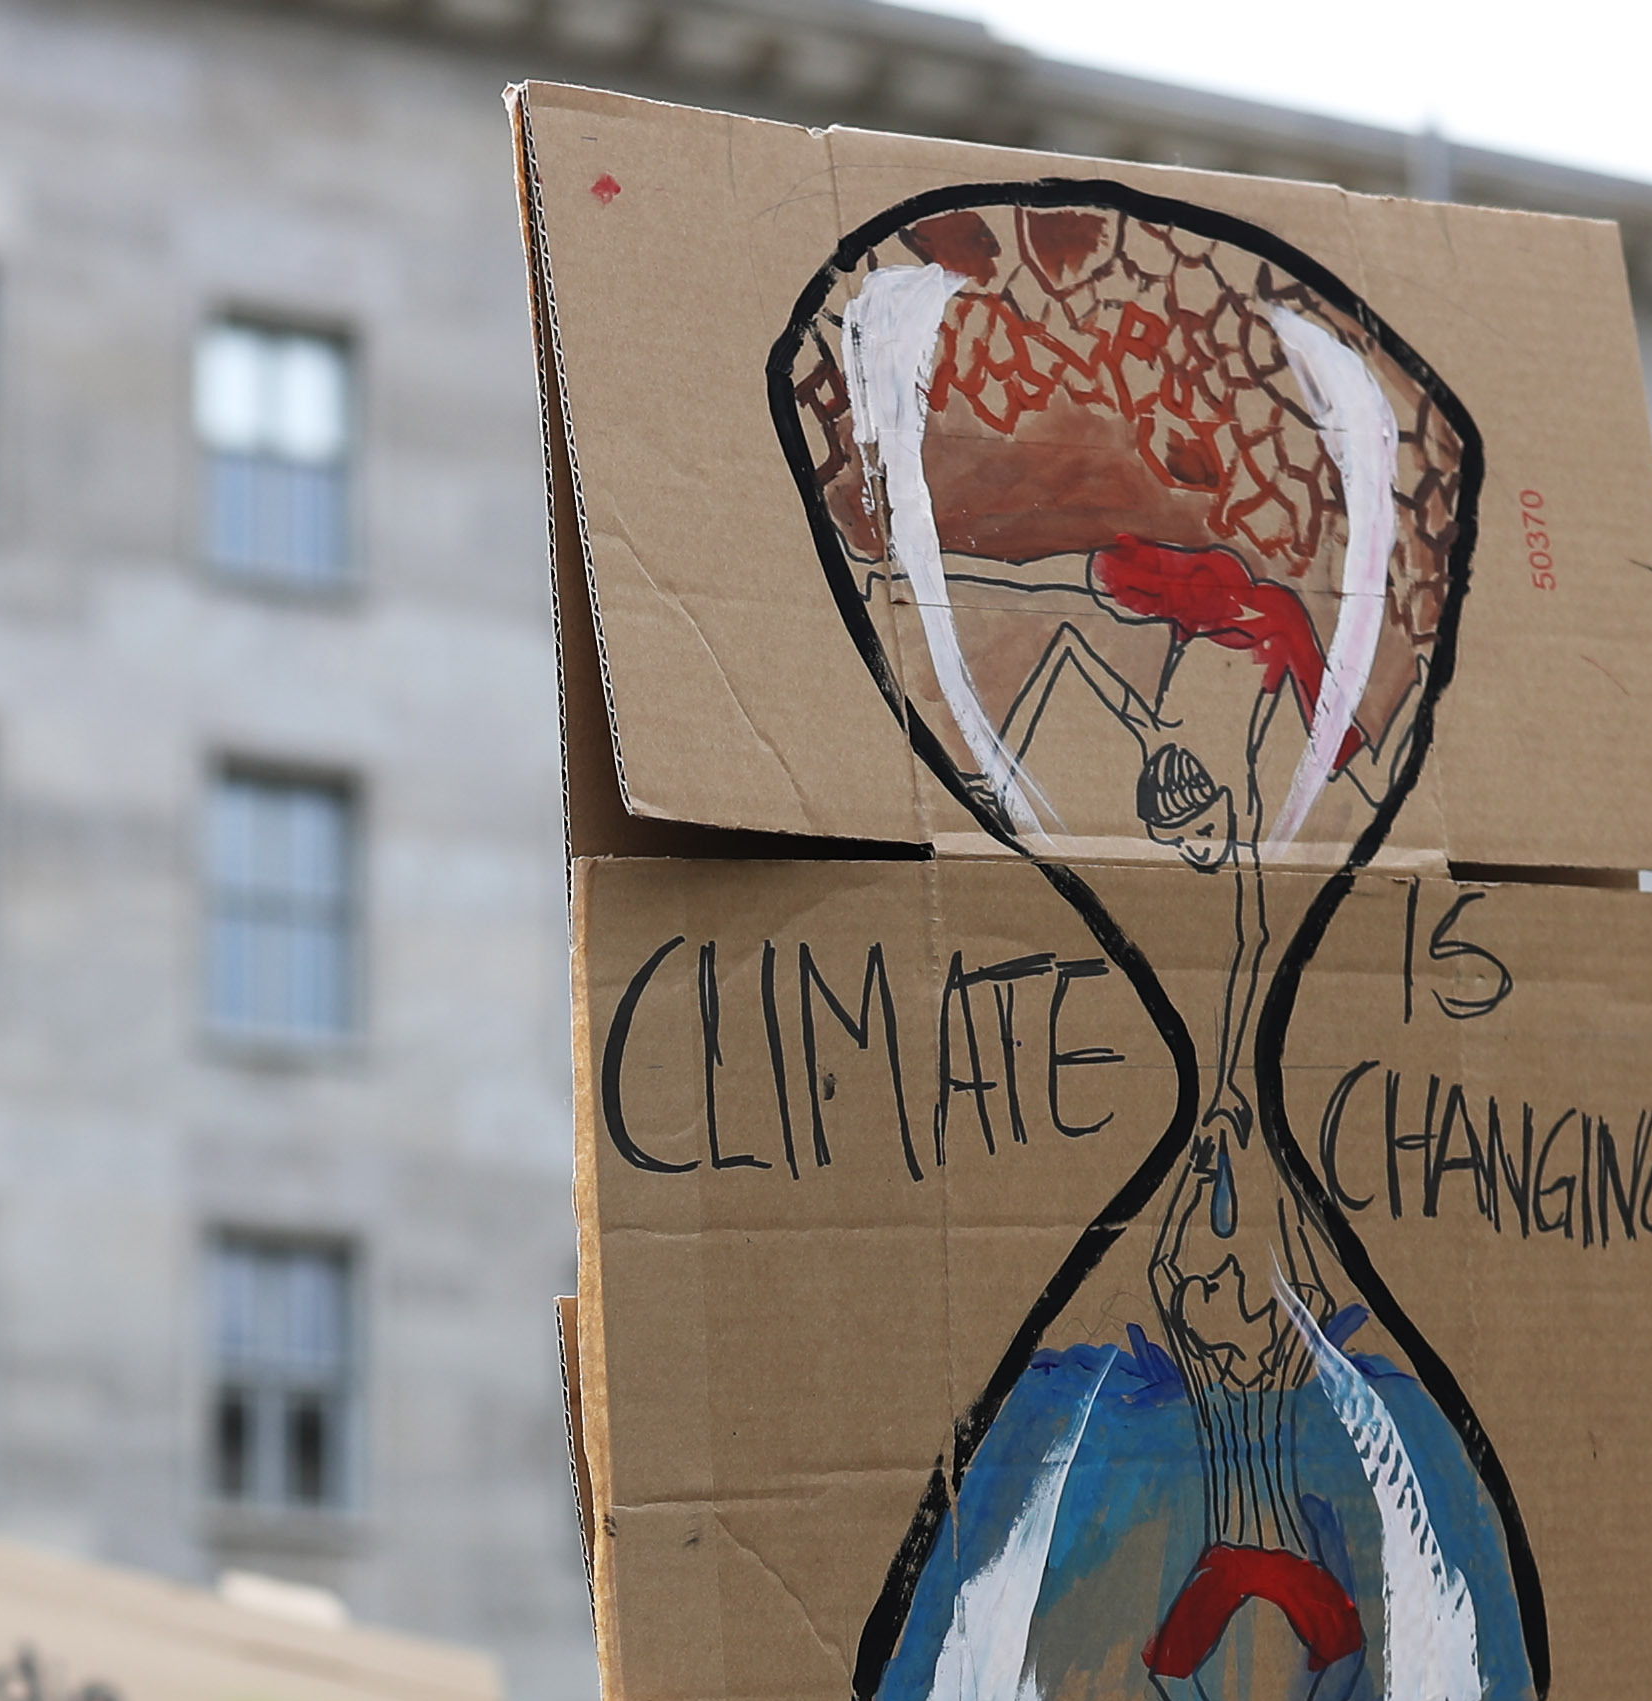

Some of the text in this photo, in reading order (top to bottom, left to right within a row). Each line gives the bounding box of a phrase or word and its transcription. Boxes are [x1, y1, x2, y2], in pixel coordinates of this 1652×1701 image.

[1519, 489, 1556, 591] 50370
[1391, 874, 1514, 1024] IS
[601, 935, 1126, 1182] CLIMATE
